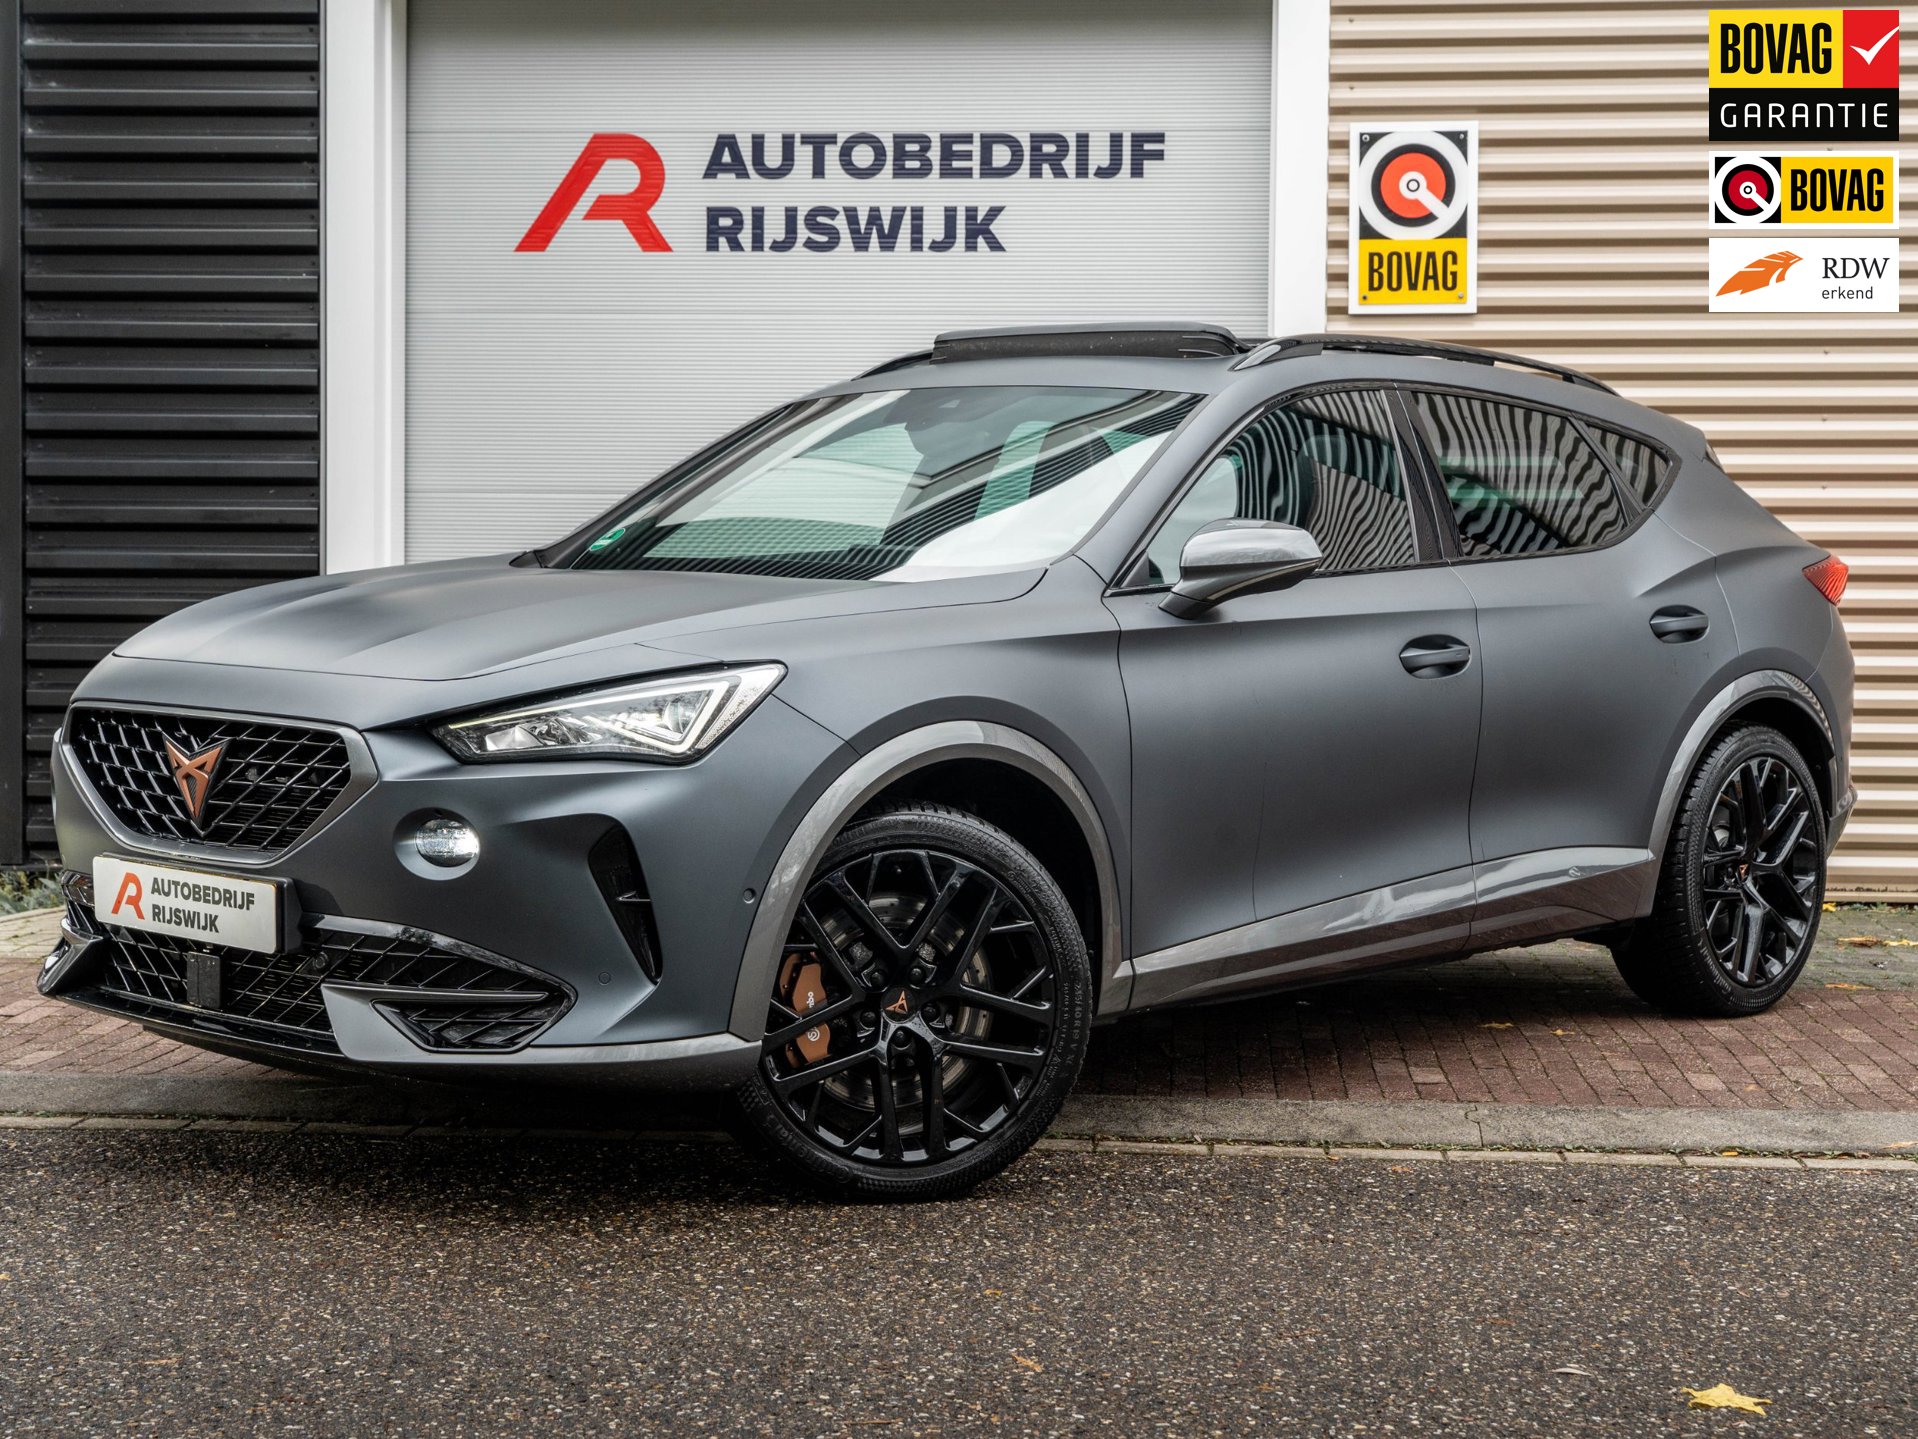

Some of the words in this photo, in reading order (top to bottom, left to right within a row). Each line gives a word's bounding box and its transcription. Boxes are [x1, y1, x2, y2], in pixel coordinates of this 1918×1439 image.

[702, 132, 1165, 179] AUTOBEDRIJF
[705, 205, 1006, 252] RIJSWIJK
[1368, 250, 1458, 292] BOVAG
[151, 877, 255, 910] AUTOBEDRIJF
[152, 904, 219, 933] RIJSWIJK
